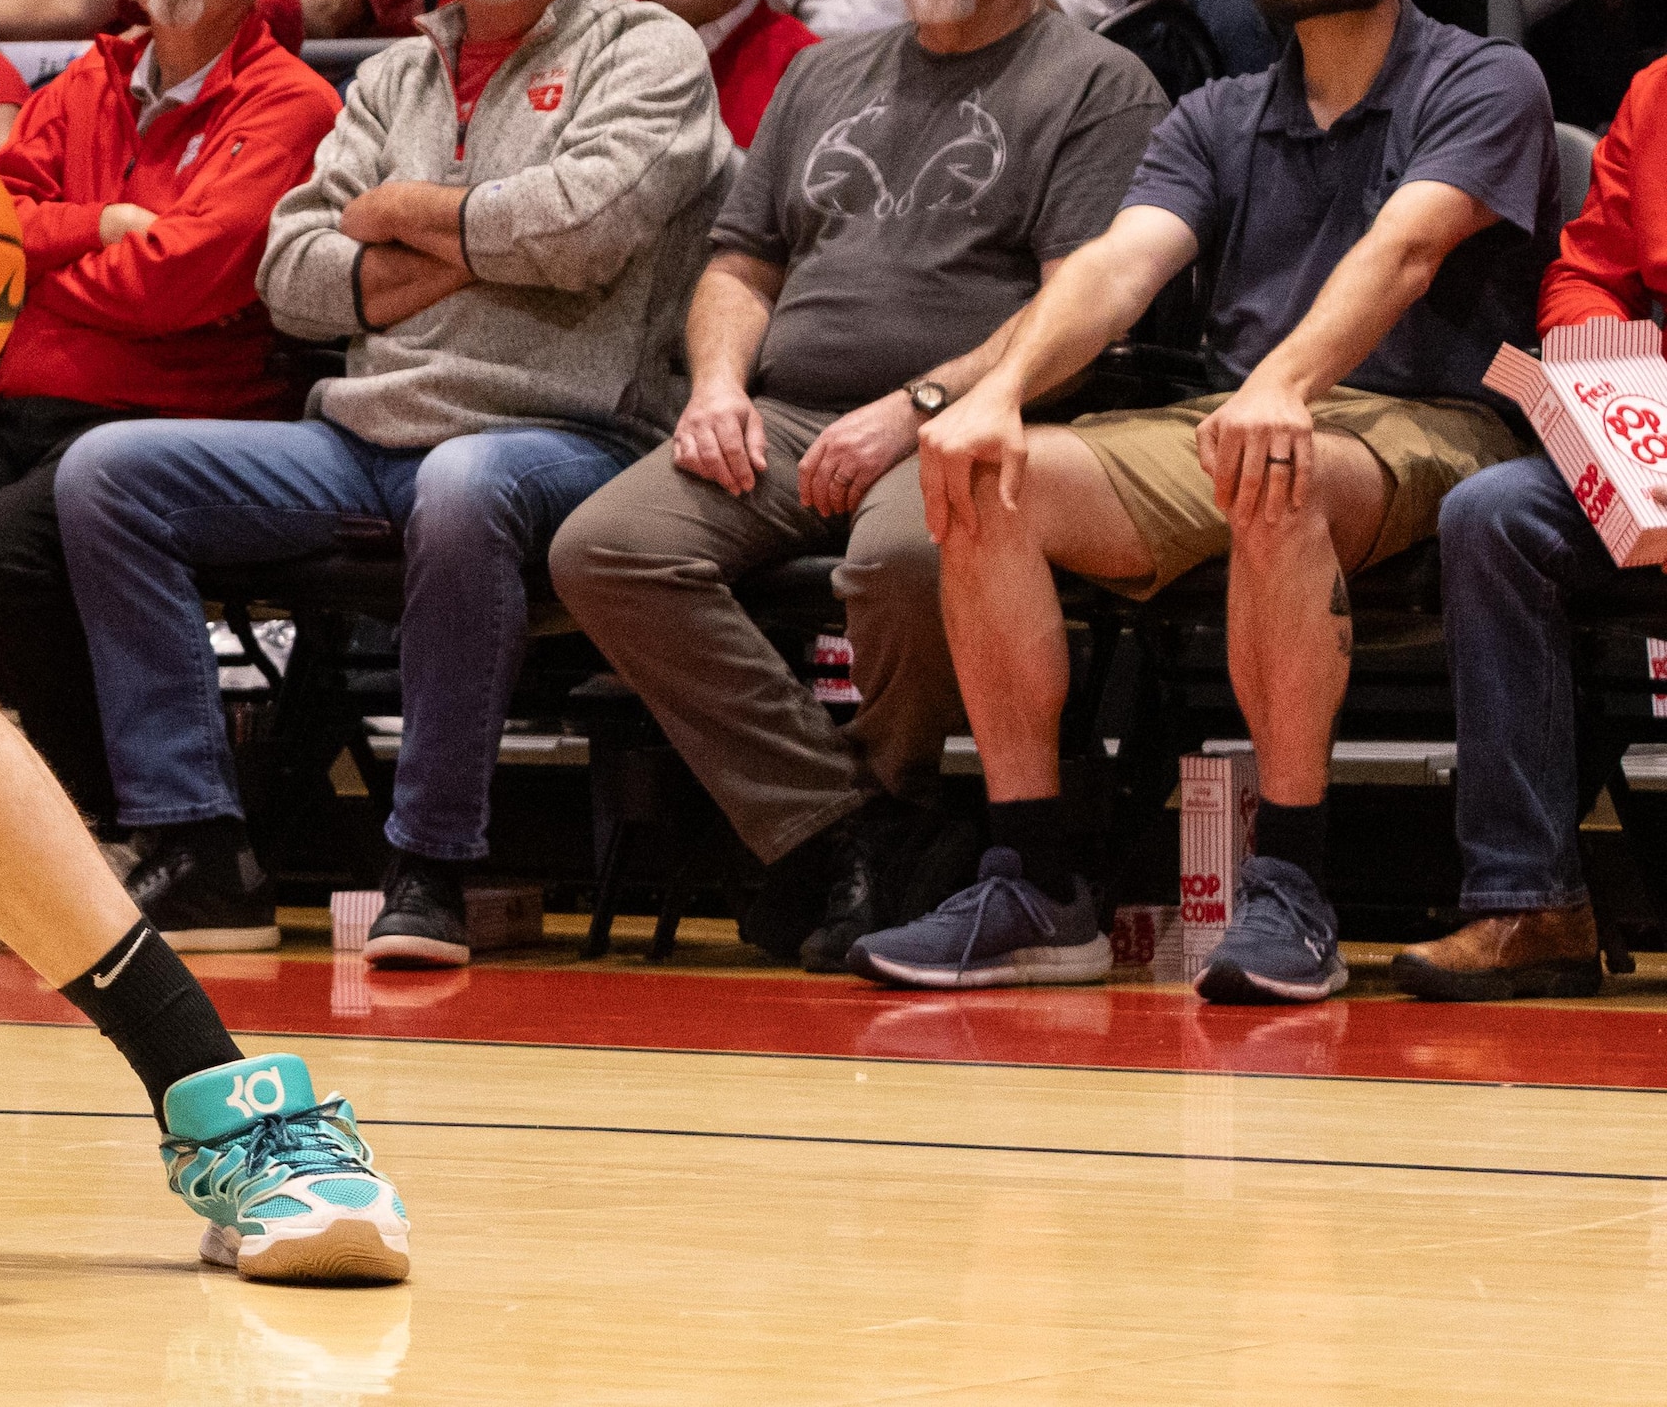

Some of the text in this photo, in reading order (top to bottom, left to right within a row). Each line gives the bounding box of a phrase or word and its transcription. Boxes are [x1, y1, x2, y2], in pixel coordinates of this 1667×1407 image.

[1574, 380, 1617, 412] fresh
[1607, 405, 1661, 441] POP
[1630, 433, 1667, 466] CO
[1180, 874, 1221, 898] POP
[1181, 902, 1226, 923] CORN
